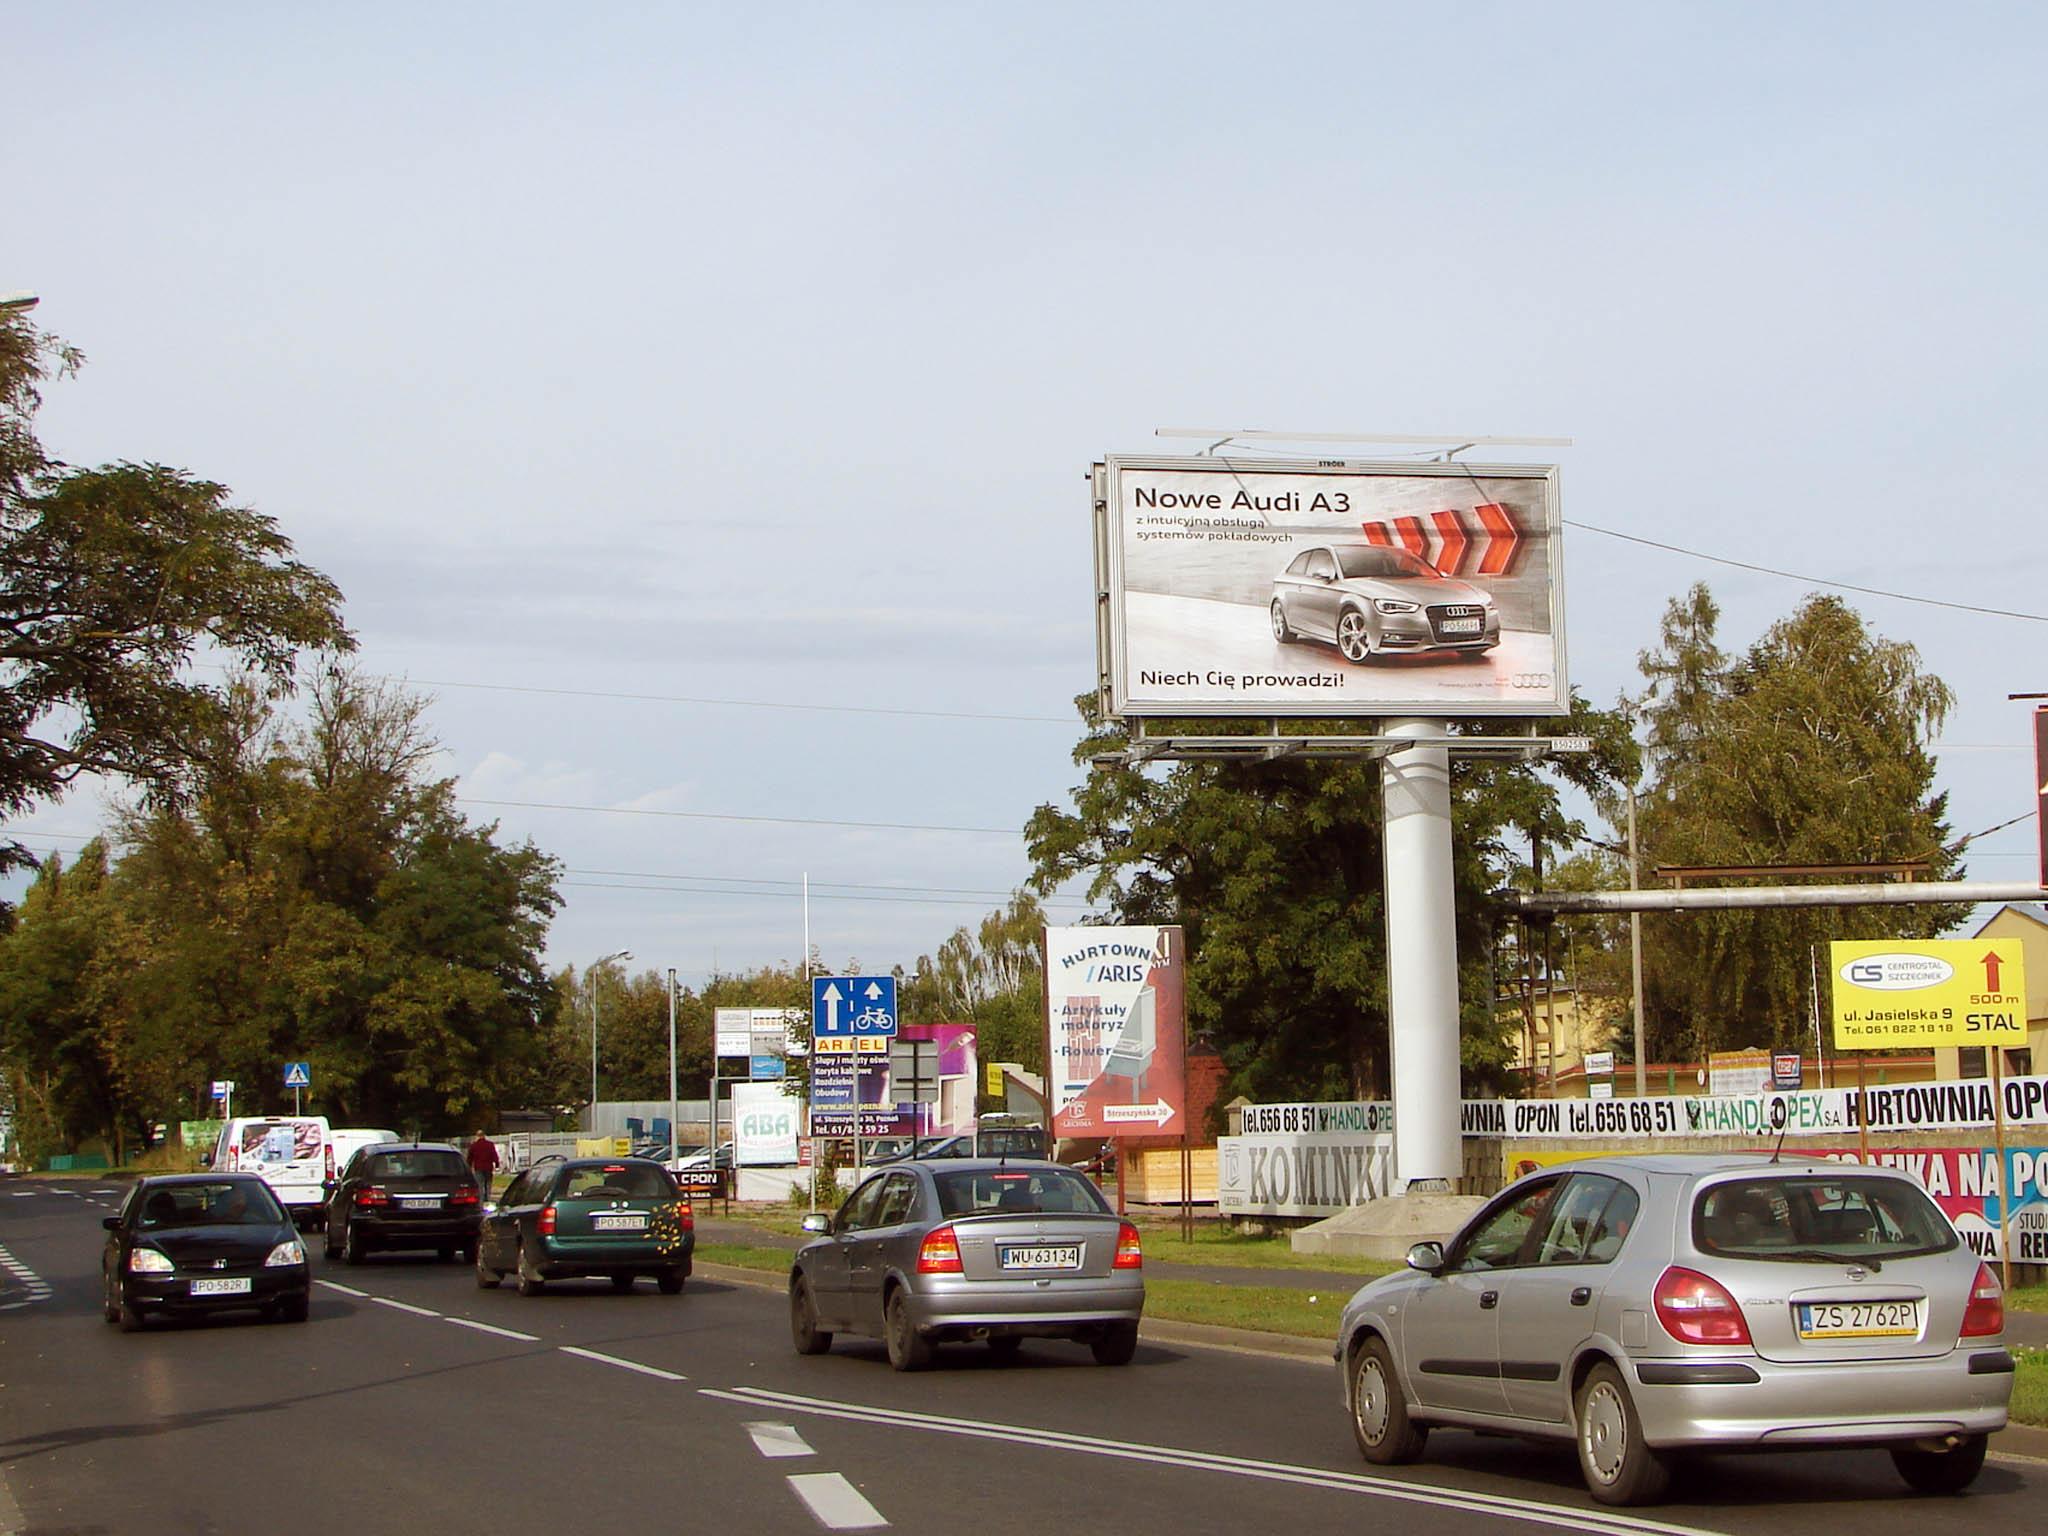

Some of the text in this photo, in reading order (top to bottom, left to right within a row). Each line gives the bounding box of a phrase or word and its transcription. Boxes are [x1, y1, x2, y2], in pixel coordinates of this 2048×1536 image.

[1135, 487, 1351, 513] Nowe Audi A3
[1136, 515, 1265, 529] z intuicyjną obsługą
[1136, 529, 1293, 545] systemów pokładowych
[1140, 671, 1345, 690] Niech Cię prowadzi!
[1887, 962, 1943, 971] CENTROSTAL
[1888, 972, 1942, 981] SZCZECINEK
[1970, 994, 2019, 1005] 500 m
[1061, 1004, 1127, 1018] Artykuły
[1844, 1008, 1953, 1021] ul. Jasielska 9
[1892, 1024, 1916, 1034] 822
[1920, 1024, 1935, 1033] 18
[1938, 1023, 1953, 1033] 18
[1966, 1013, 2020, 1031] STAL
[1515, 1104, 1560, 1132] OPON
[1630, 1102, 1651, 1132] 68
[1656, 1101, 1677, 1131] 51
[1704, 1095, 1825, 1131] HANDLOPEX
[1846, 1084, 1995, 1127] HURTOWNIA
[743, 1113, 791, 1137] ABA
[1283, 1107, 1299, 1132] 68
[1302, 1106, 1316, 1131] 51
[831, 1125, 865, 1136] 61/82
[866, 1125, 877, 1134] 59
[878, 1125, 889, 1134] 25
[1248, 1145, 1390, 1207] KOMINKI
[1012, 1249, 1075, 1263] WU 63134
[199, 1281, 214, 1291] PO
[1814, 1304, 1911, 1328] ZS 2762P
